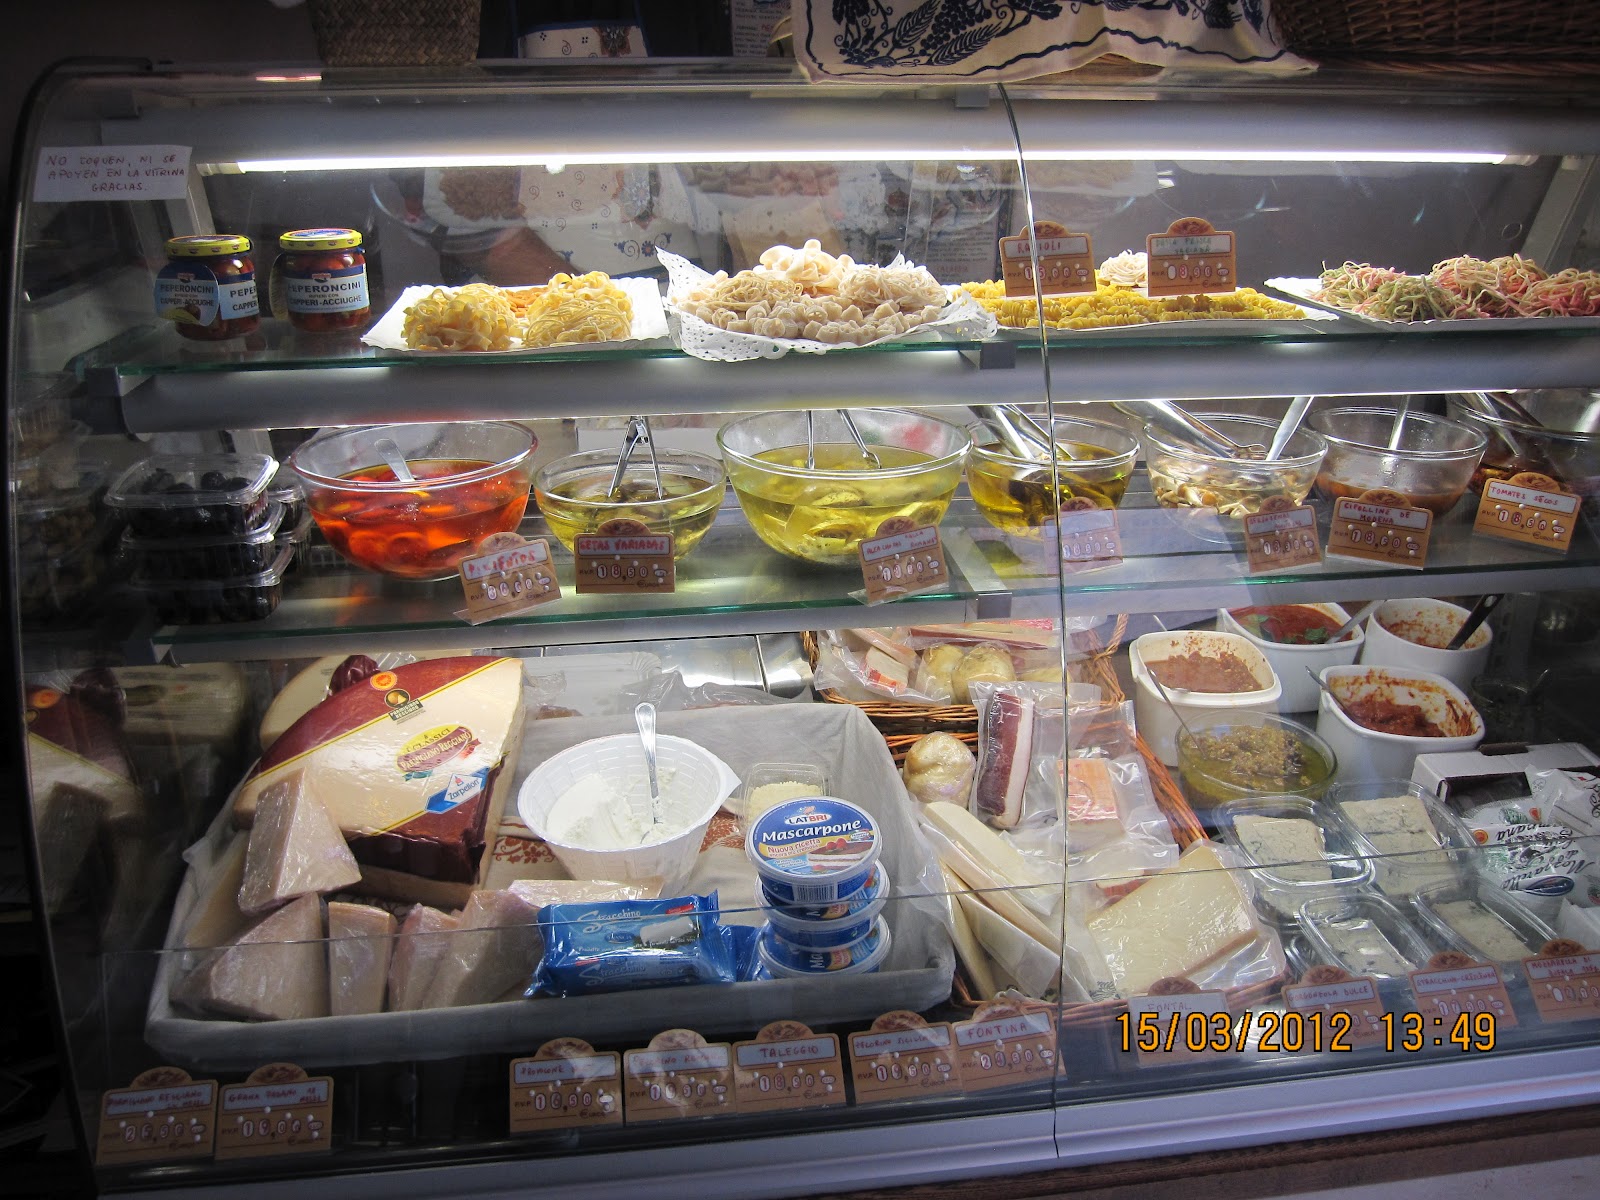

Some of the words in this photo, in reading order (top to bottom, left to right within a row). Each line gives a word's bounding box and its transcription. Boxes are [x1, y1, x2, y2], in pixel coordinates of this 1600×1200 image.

[46, 155, 67, 166] NO
[140, 156, 152, 164] NI
[163, 154, 177, 163] SE
[48, 169, 98, 180] APOYEN
[106, 168, 123, 177] EN
[127, 169, 139, 178] LA
[145, 167, 185, 178] VITRINA
[1018, 240, 1061, 254] RAIOLI
[160, 284, 214, 294] PEPERONCINI
[287, 281, 361, 293] PEPERONCINI
[1491, 486, 1526, 499] TOMATES
[1533, 496, 1559, 505] SECOS
[1359, 514, 1395, 525] MODENA
[579, 539, 610, 551] SETAS
[614, 538, 665, 551] VARIADAS
[598, 564, 648, 582] 18,50
[400, 747, 441, 770] PARMIGIANO
[438, 732, 471, 751] REGGIANO
[788, 814, 828, 825] LATBRI
[762, 820, 862, 843] Mascarpone
[767, 844, 794, 854] Nuova
[795, 838, 821, 850] ricetta
[577, 908, 642, 934] Stracchino
[1344, 985, 1368, 996] DULCE
[1147, 1001, 1192, 1012] FONTAL
[967, 1022, 1027, 1039] FONTINA
[760, 1045, 819, 1058] TALEGGIO
